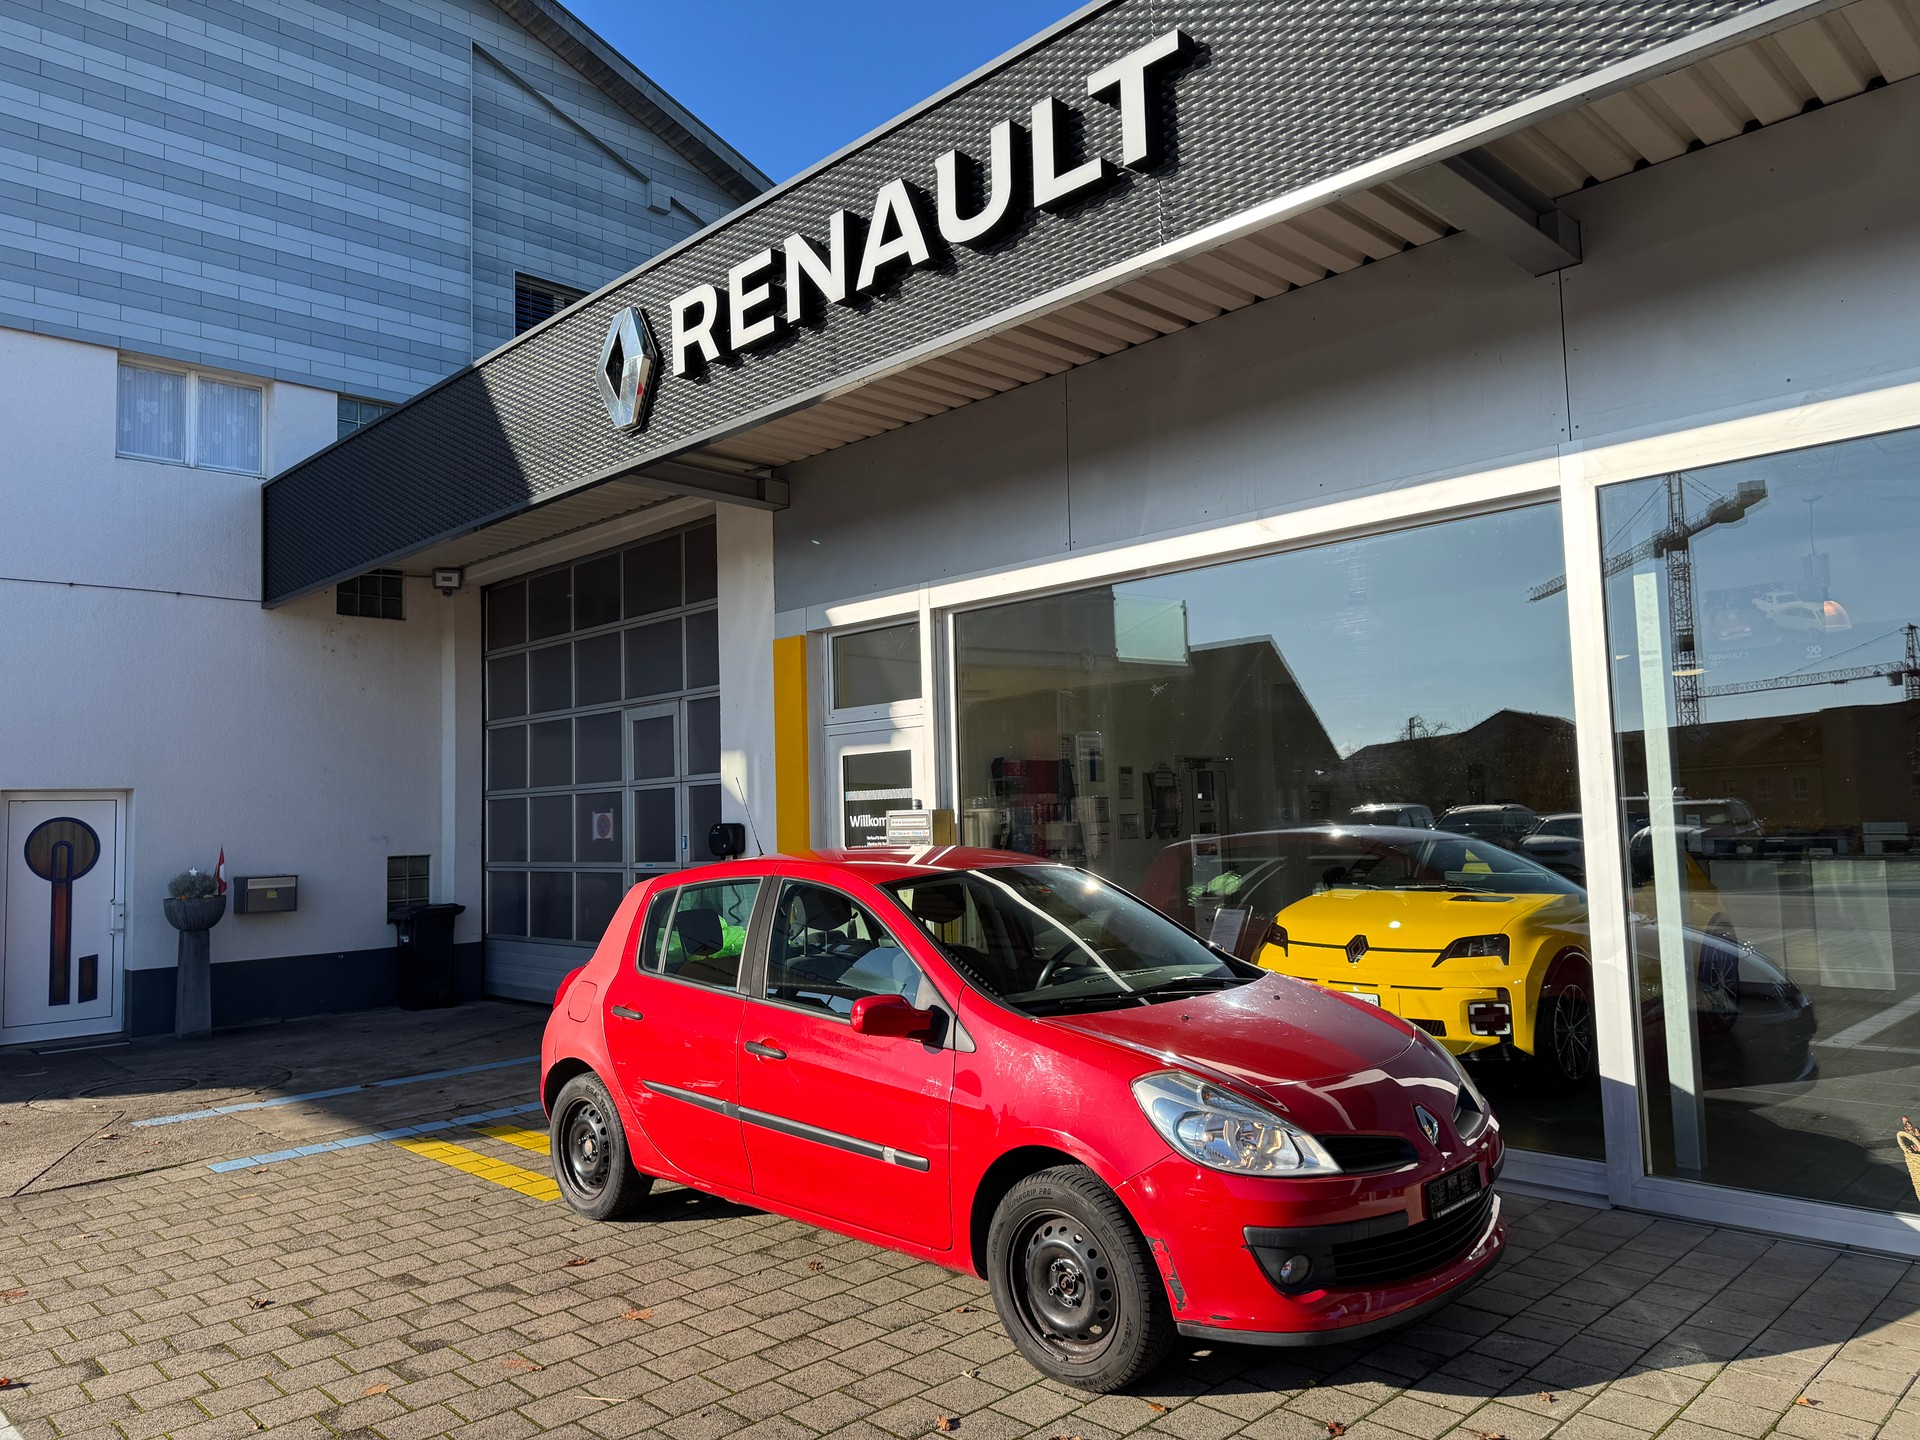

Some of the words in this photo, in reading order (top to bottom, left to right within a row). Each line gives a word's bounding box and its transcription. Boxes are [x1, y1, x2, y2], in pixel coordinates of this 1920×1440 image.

[670, 28, 1186, 378] RENAULT
[1708, 652, 1743, 660] RENAULT
[1007, 1188, 1037, 1210] SUPERGRIP
[1038, 1187, 1052, 1195] PRO
